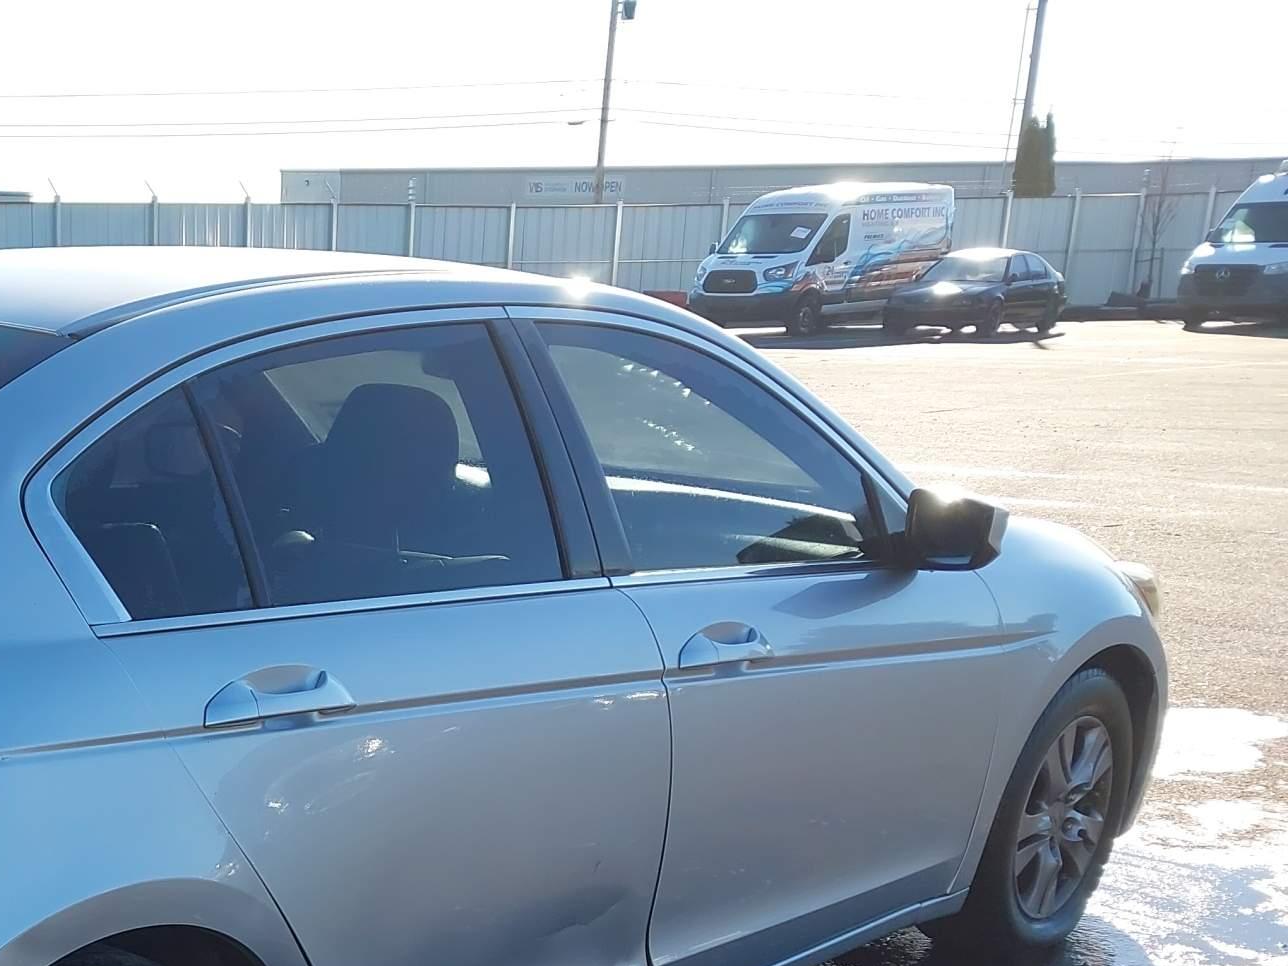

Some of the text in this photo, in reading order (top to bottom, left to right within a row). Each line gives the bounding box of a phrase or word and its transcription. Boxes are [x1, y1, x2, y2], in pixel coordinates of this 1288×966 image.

[604, 181, 623, 192] PEN
[862, 208, 889, 221] HOME
[891, 207, 931, 219] COMFORT
